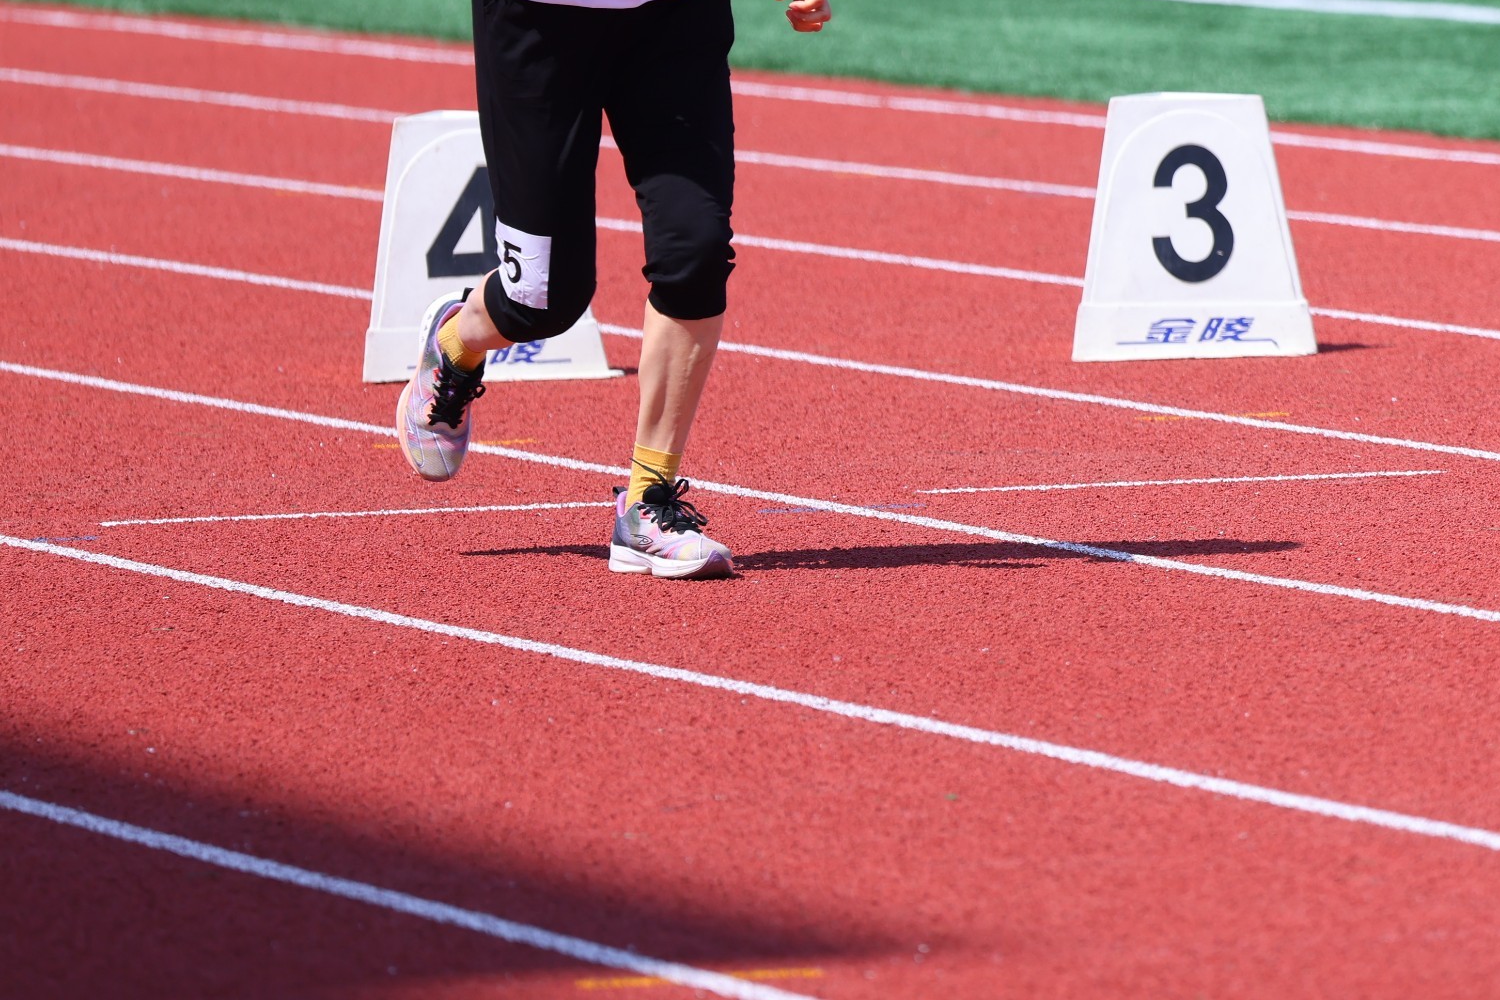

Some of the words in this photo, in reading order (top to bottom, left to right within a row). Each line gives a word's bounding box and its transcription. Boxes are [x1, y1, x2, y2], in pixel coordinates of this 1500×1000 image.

[426, 165, 500, 278] 4
[1152, 143, 1234, 283] 3
[503, 240, 522, 284] 5
[1146, 316, 1255, 343] 金陵
